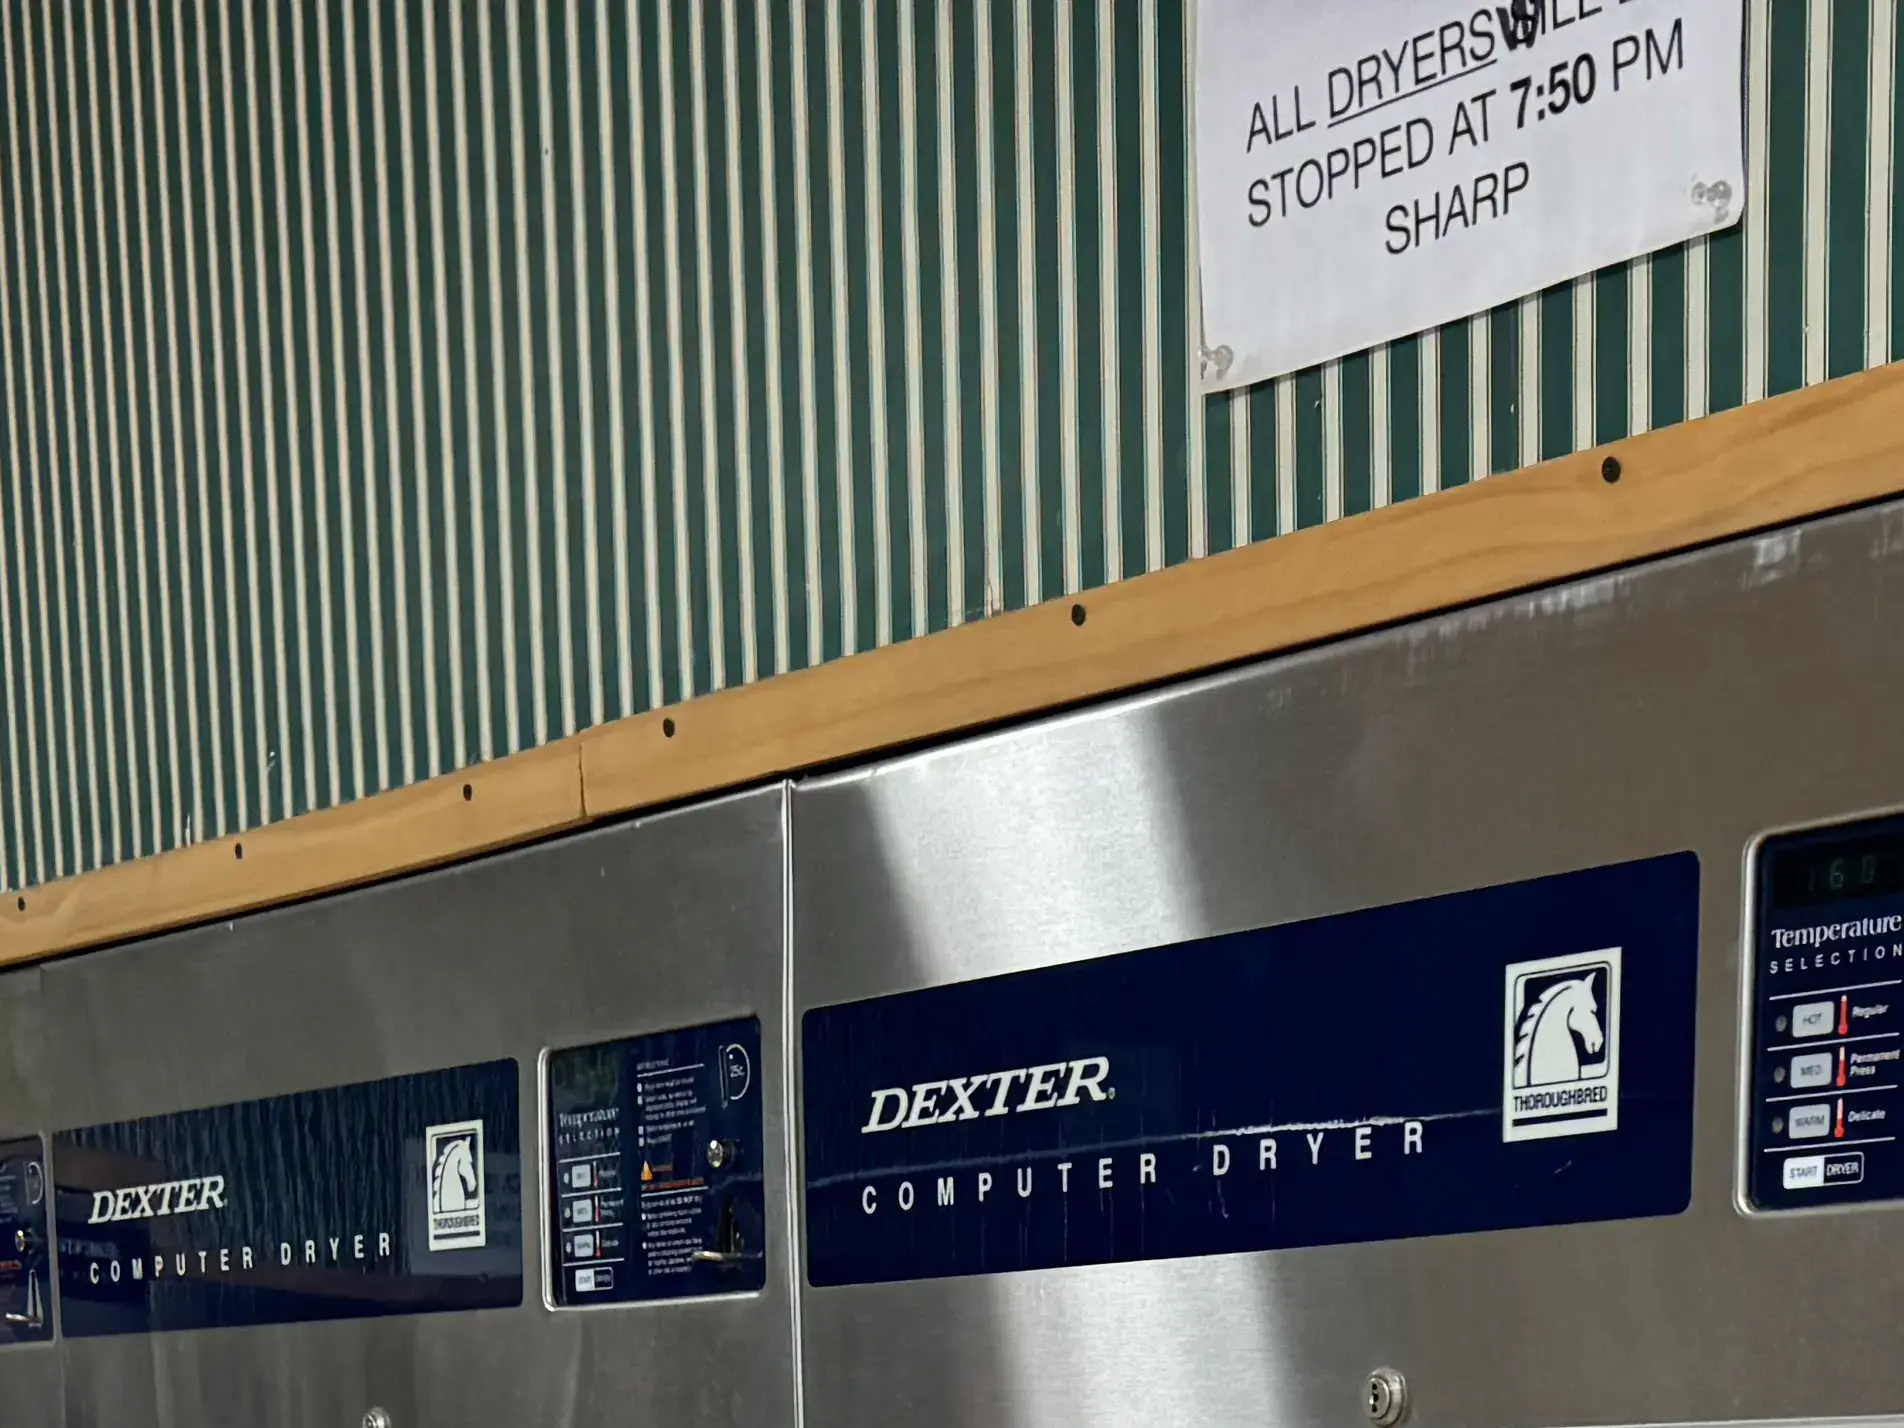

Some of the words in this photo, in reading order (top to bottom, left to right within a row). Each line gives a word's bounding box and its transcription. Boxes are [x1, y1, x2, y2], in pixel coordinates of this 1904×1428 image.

[1245, 84, 1317, 153] ALL
[1326, 10, 1497, 118] DRYERS
[1248, 117, 1435, 227] STOPPED
[1449, 89, 1498, 155] AT
[1509, 53, 1597, 129] 7:50
[1611, 17, 1685, 92] PM
[1384, 161, 1530, 255] SHARP
[1769, 943, 1903, 974] SELECTION
[1771, 914, 1902, 948] Temperature
[861, 1056, 1111, 1135] DEXTER
[1513, 1085, 1609, 1113] THOROUGHBRED
[861, 1152, 1158, 1215] COMPUTER
[1213, 1121, 1426, 1178] DRYER
[1788, 1165, 1820, 1180] START
[1826, 1161, 1860, 1177] DRYER
[87, 1174, 227, 1225] DEXTER
[88, 1245, 255, 1286] COMPUTER
[280, 1231, 393, 1268] DRYER
